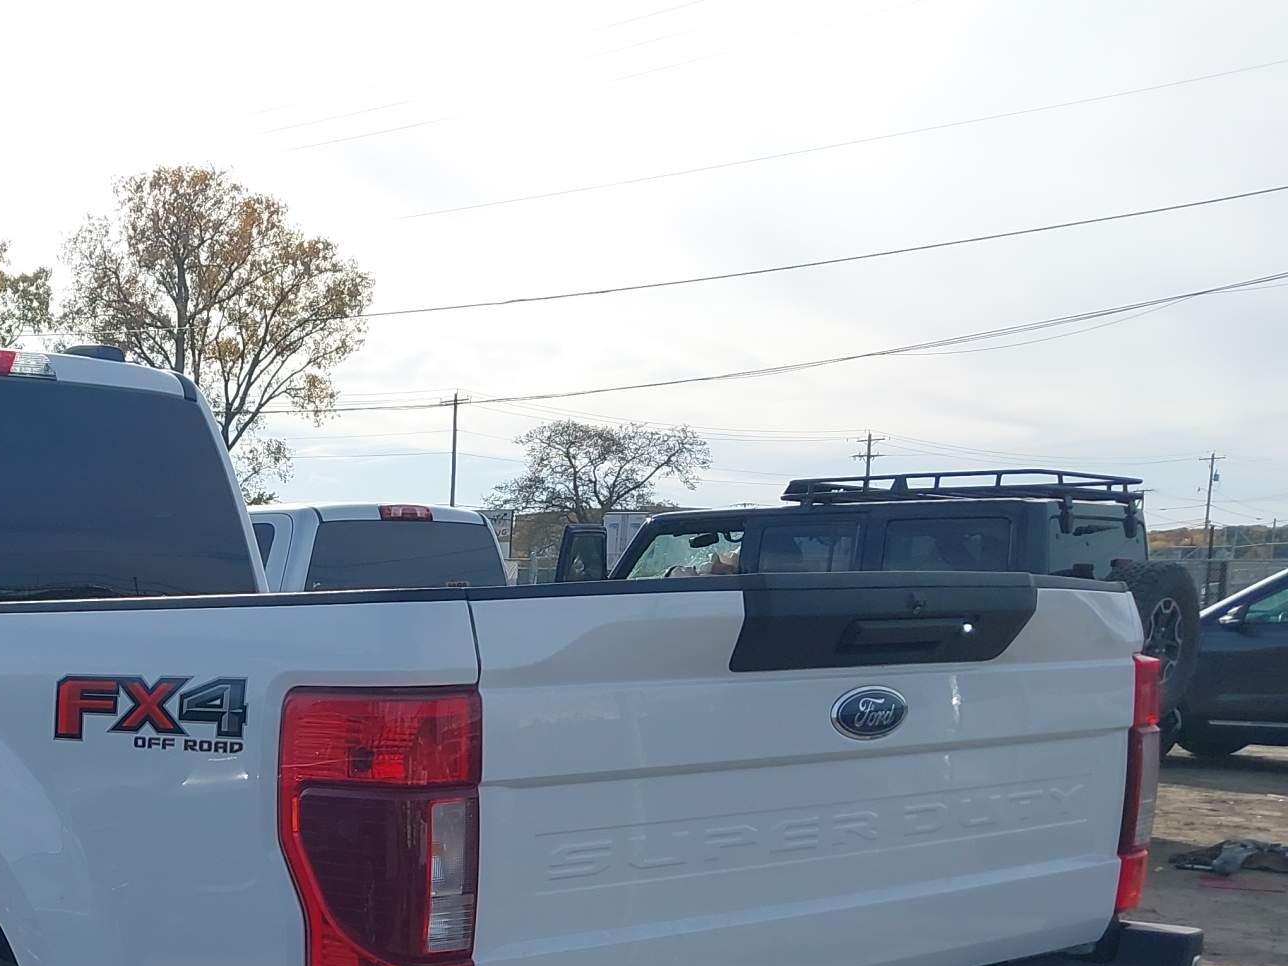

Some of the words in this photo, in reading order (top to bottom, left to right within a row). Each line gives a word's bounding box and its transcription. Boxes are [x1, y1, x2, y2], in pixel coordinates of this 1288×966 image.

[54, 675, 248, 740] FX4
[855, 697, 896, 728] Ford
[134, 736, 175, 750] OFF
[184, 738, 244, 754] ROAD
[548, 807, 878, 881] SUPER
[904, 783, 1085, 836] DUTY
